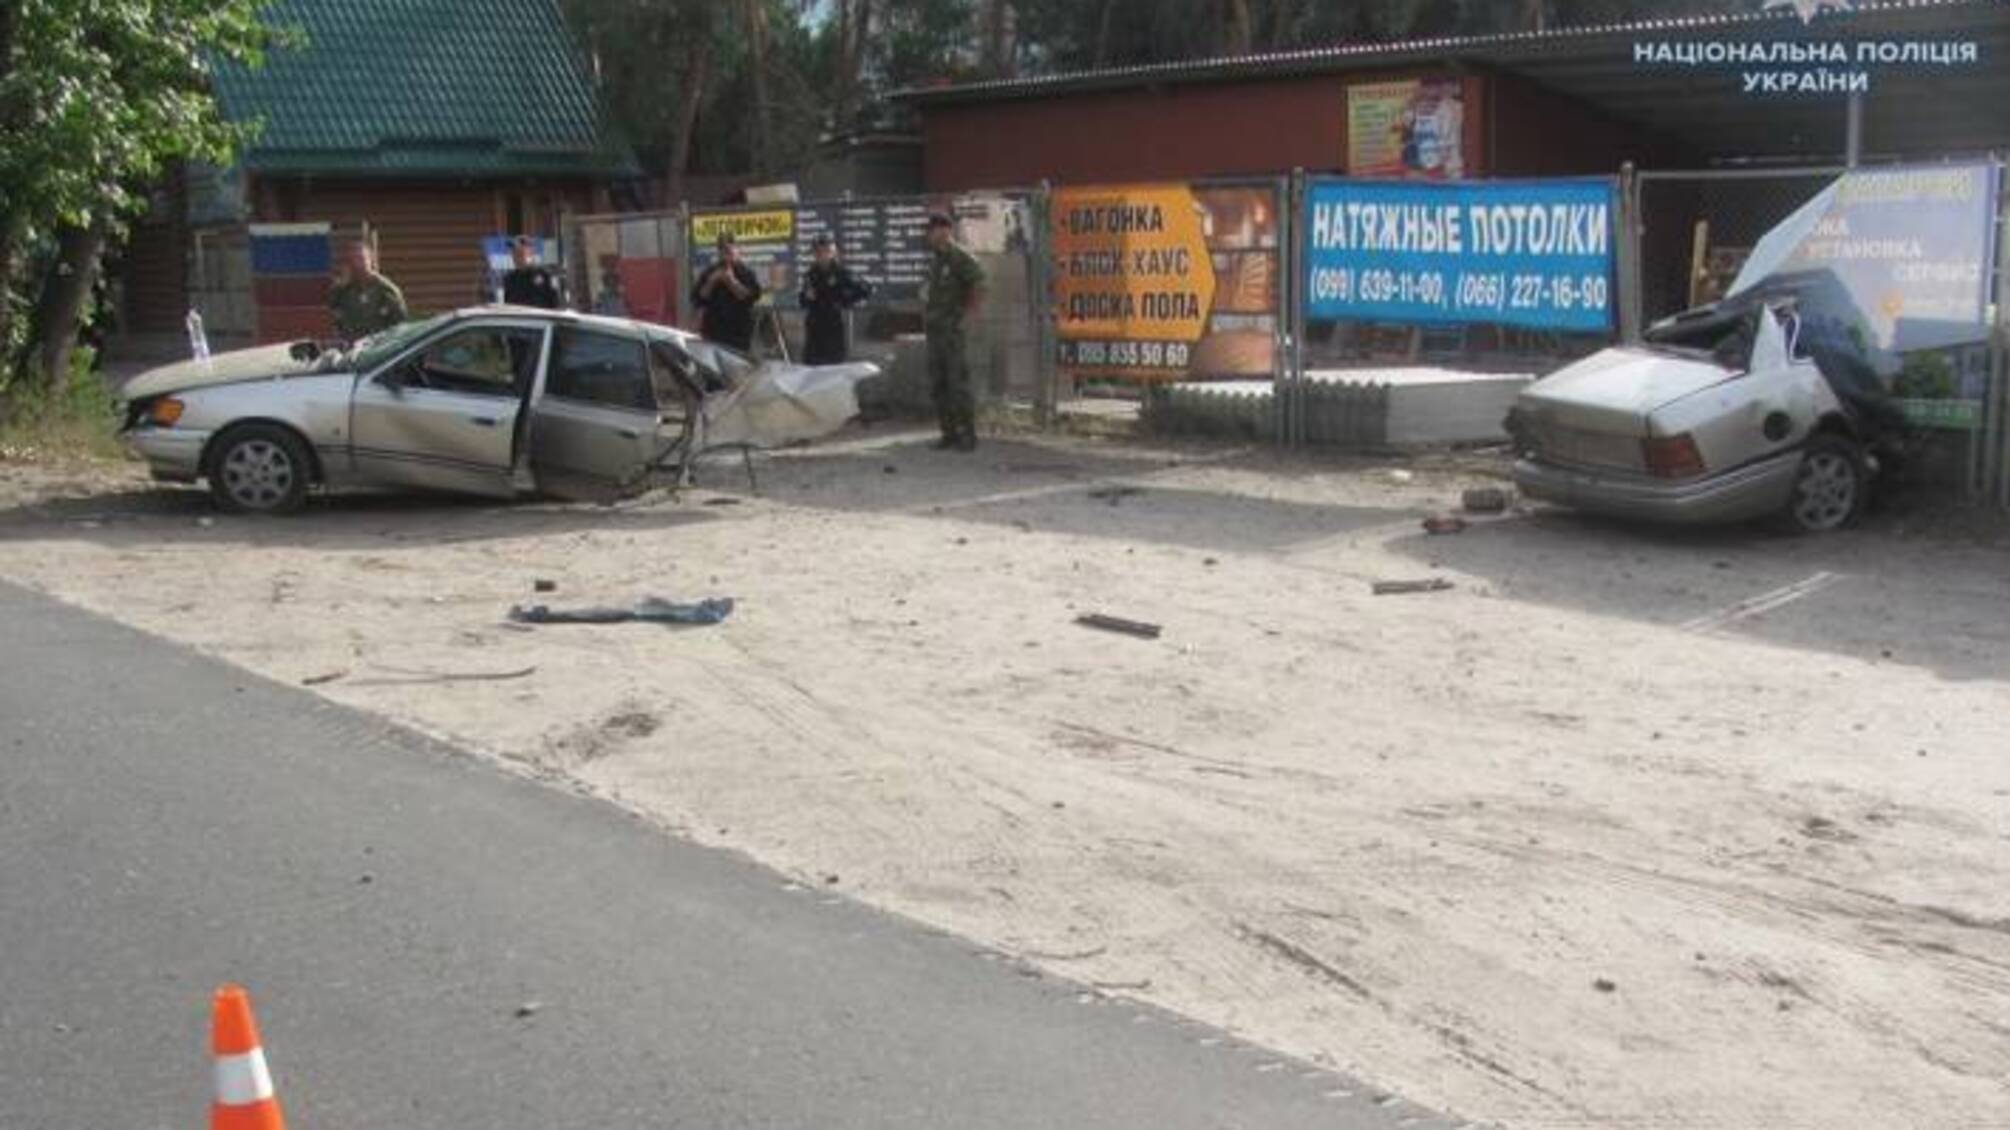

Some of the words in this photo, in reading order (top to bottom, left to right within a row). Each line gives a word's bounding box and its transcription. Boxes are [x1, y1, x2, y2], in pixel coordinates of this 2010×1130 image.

[1070, 205, 1164, 235] ВАГОНКА
[1313, 203, 1461, 252] НАТЯЖНЫЕ
[1470, 204, 1607, 254] ПОТОЛКИ
[1069, 292, 1134, 322] ДОСКА
[1141, 292, 1199, 319] ПОЛА
[1310, 265, 1355, 304] (099)
[1455, 273, 1505, 312] (066)
[1511, 274, 1607, 309] 227-16-90
